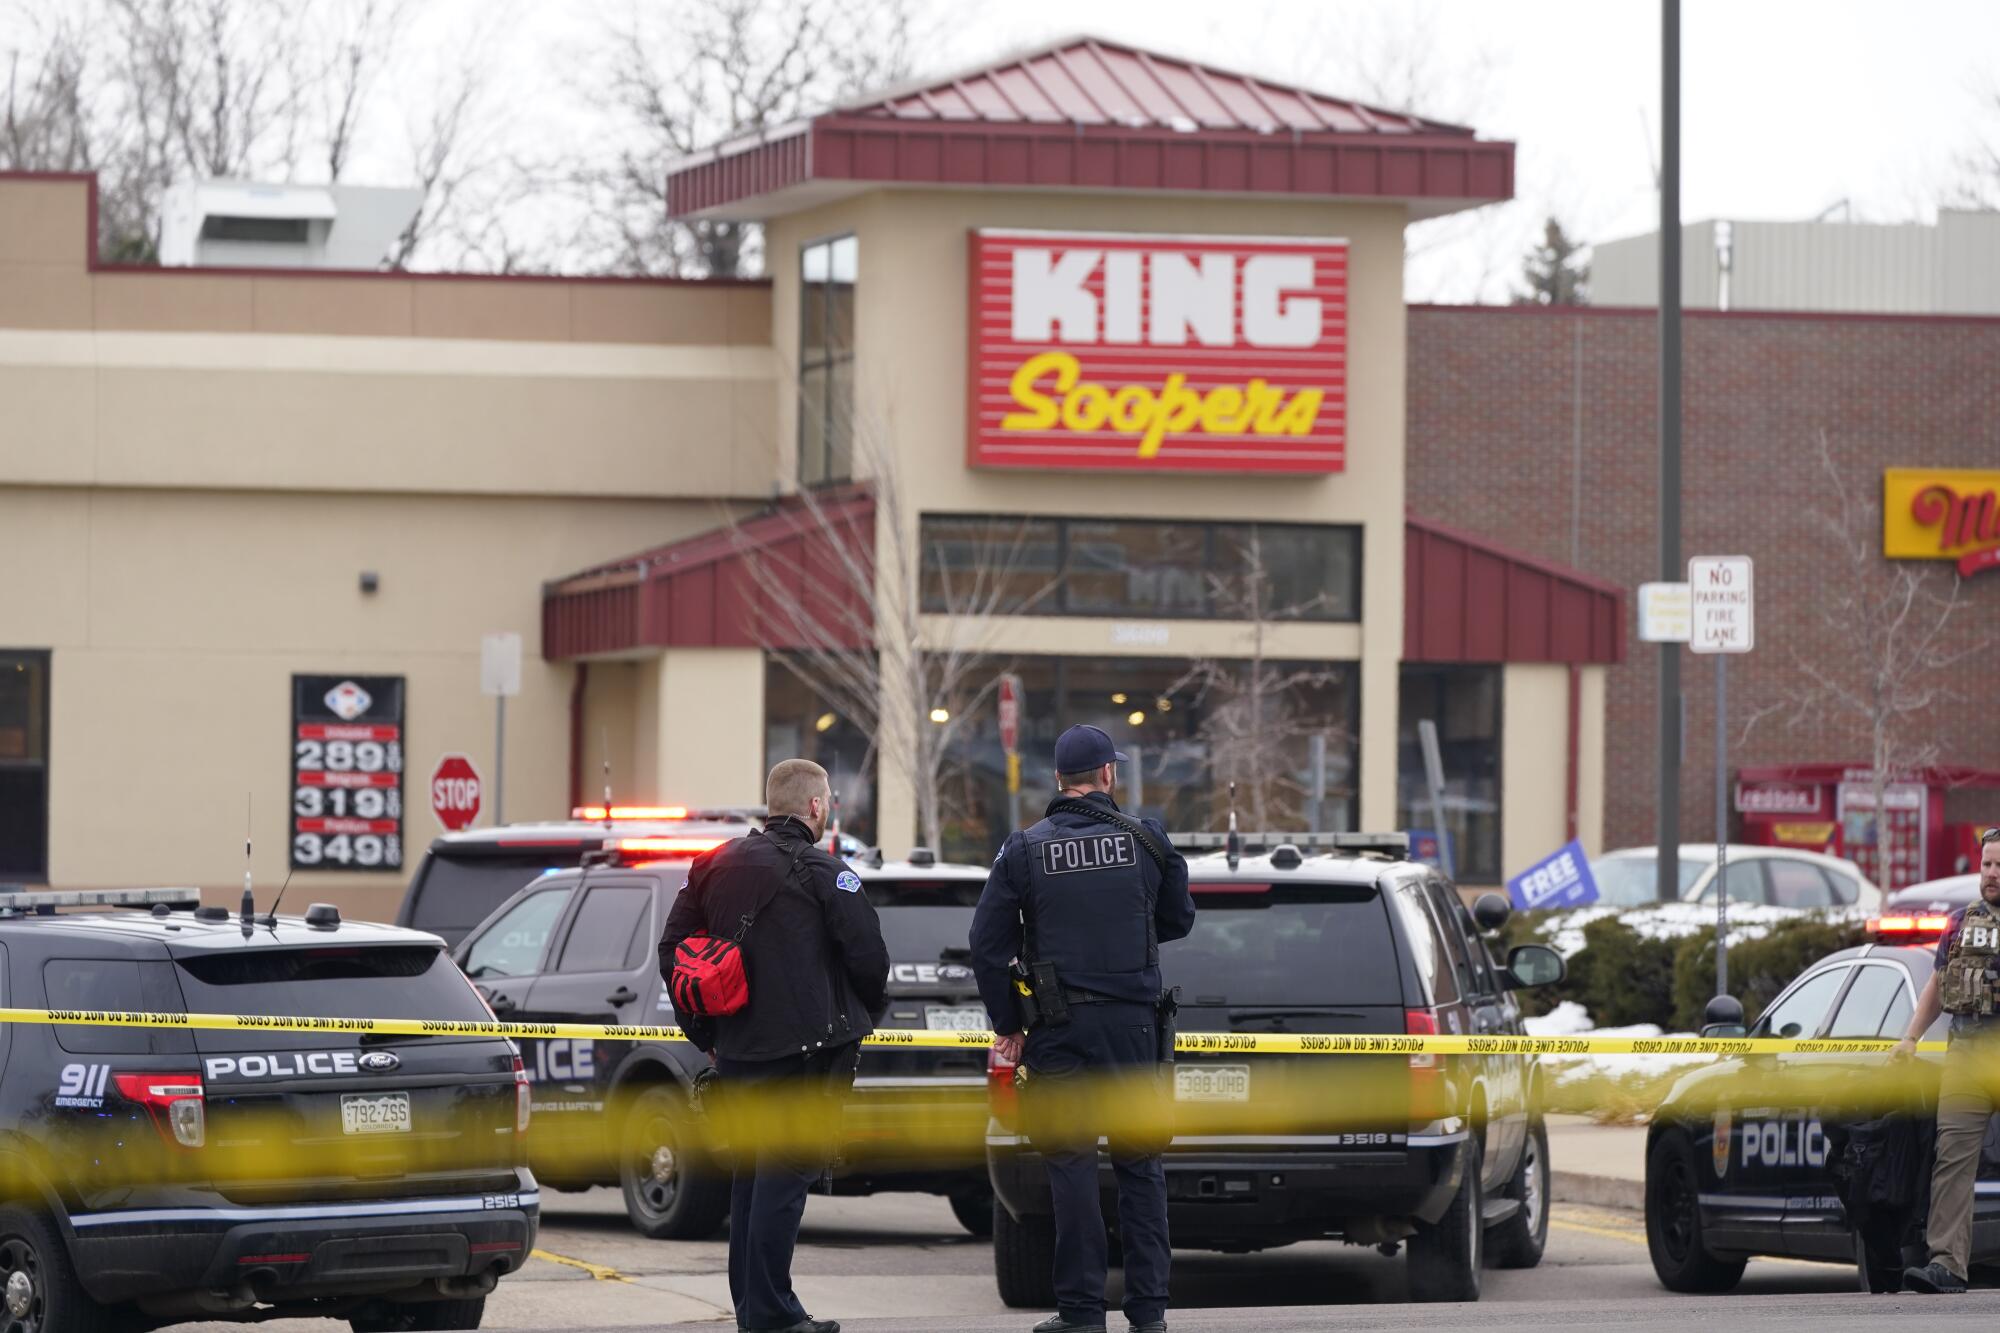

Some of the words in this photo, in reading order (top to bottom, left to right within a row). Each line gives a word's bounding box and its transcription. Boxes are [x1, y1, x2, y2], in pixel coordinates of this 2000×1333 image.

[1011, 248, 1323, 348] KING
[1001, 351, 1326, 458] Soopers
[1710, 568, 1732, 585] NO
[1696, 591, 1747, 604] PARKING
[1706, 609, 1735, 622] FIRE
[1705, 627, 1736, 641] LANE
[295, 740, 384, 771] 289
[433, 779, 478, 810] STOP
[295, 787, 384, 818] 319
[294, 833, 384, 865] 349
[1050, 837, 1128, 870] POLICE
[1520, 852, 1579, 900] FREE
[1960, 927, 1998, 948] FBI
[887, 964, 939, 982] ICE
[1185, 1035, 1198, 1047] DO
[1201, 1036, 1221, 1048] LINE
[1223, 1036, 1257, 1049] POLICE
[1300, 1036, 1331, 1050] CROSS
[1332, 1037, 1352, 1050] NOT
[1354, 1037, 1367, 1050] DO
[1369, 1038, 1390, 1050] LINE
[1391, 1038, 1424, 1051] POLICE
[1467, 1039, 1498, 1052] CROSS
[1499, 1039, 1518, 1052] NOT
[1520, 1040, 1533, 1053] DO
[1534, 1040, 1555, 1053] LINE
[1557, 1040, 1590, 1053] POLICE
[1631, 1040, 1662, 1053] CROSS
[1663, 1041, 1682, 1053] NOT
[1682, 1042, 1697, 1053] DO
[1699, 1042, 1718, 1053] LINE
[1721, 1042, 1753, 1054] POLICE
[205, 1052, 358, 1080] POLICE
[517, 1038, 595, 1081] LICE
[58, 1064, 110, 1097] 911
[55, 1096, 104, 1108] EMERGENCY
[1341, 1133, 1388, 1144] 3518
[1742, 1122, 1832, 1168] POLIC
[485, 1195, 518, 1209] 2515
